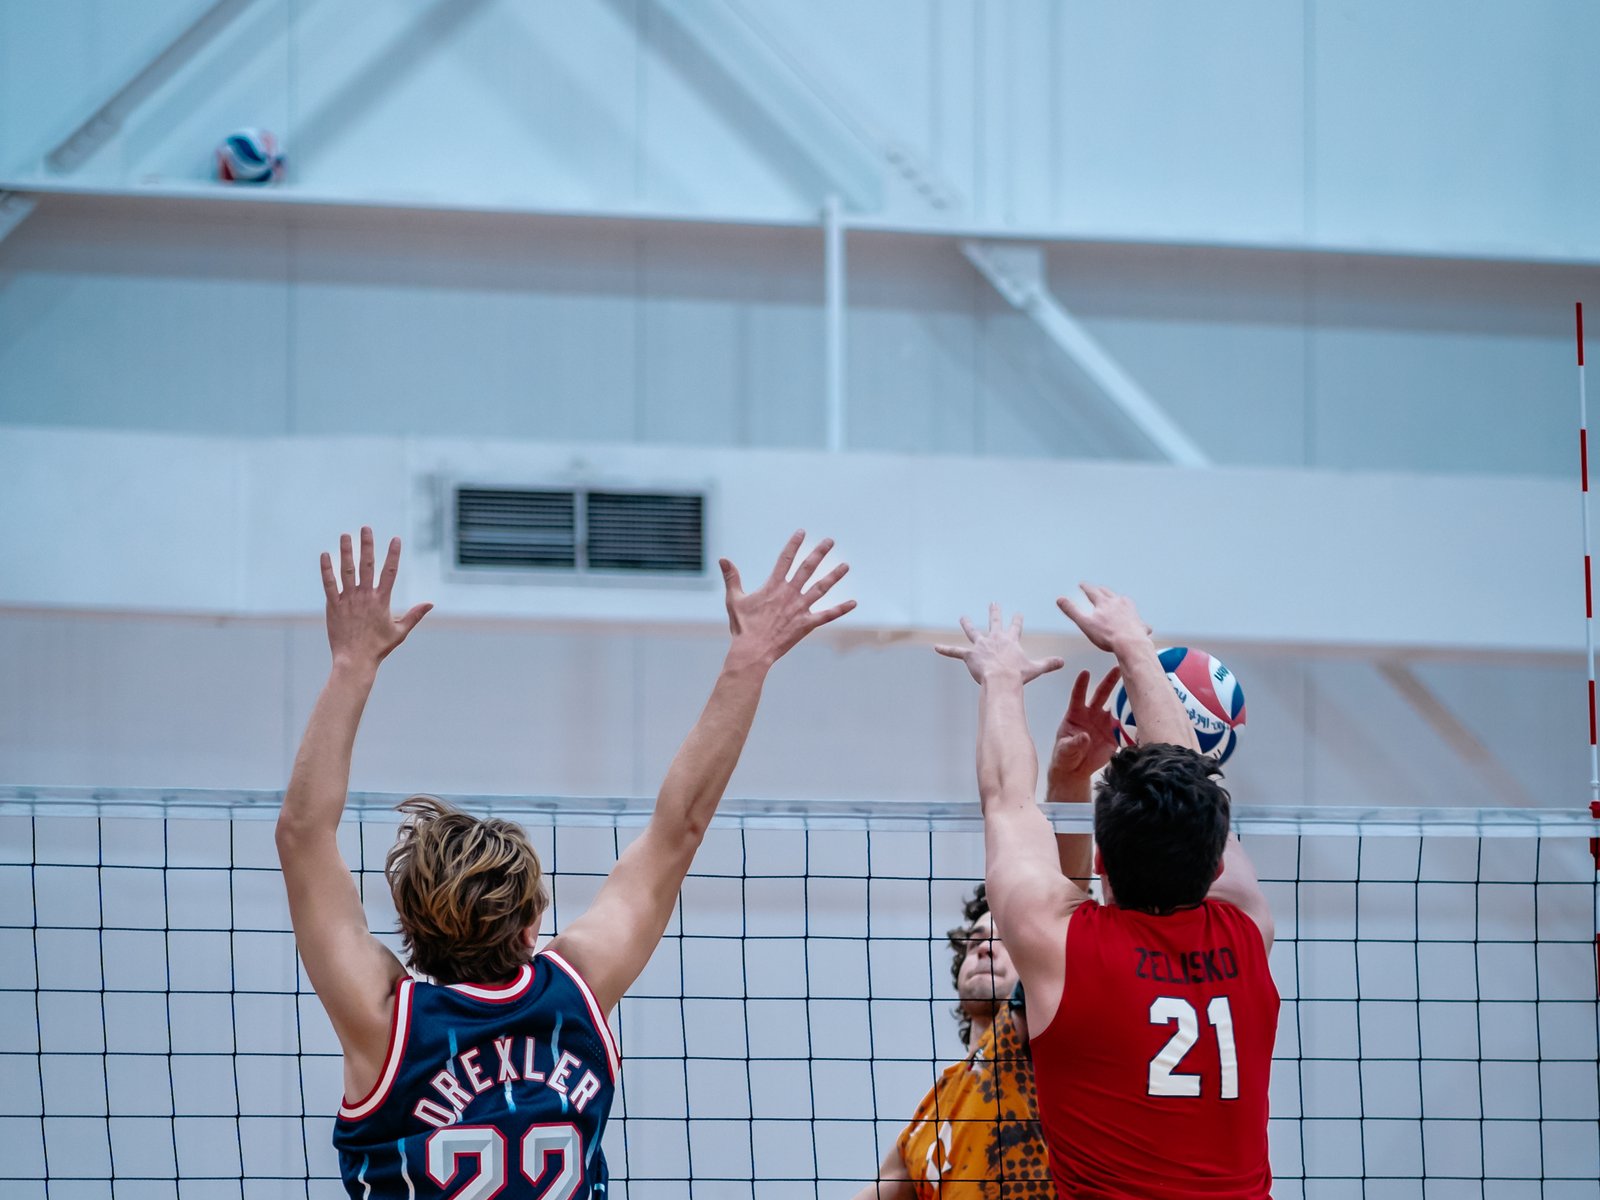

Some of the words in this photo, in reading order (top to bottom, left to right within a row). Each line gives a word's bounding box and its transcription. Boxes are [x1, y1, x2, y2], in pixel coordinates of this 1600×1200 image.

[1135, 946, 1239, 984] ZELISKO
[412, 1035, 601, 1128] DREXLER
[1147, 995, 1239, 1100] 21
